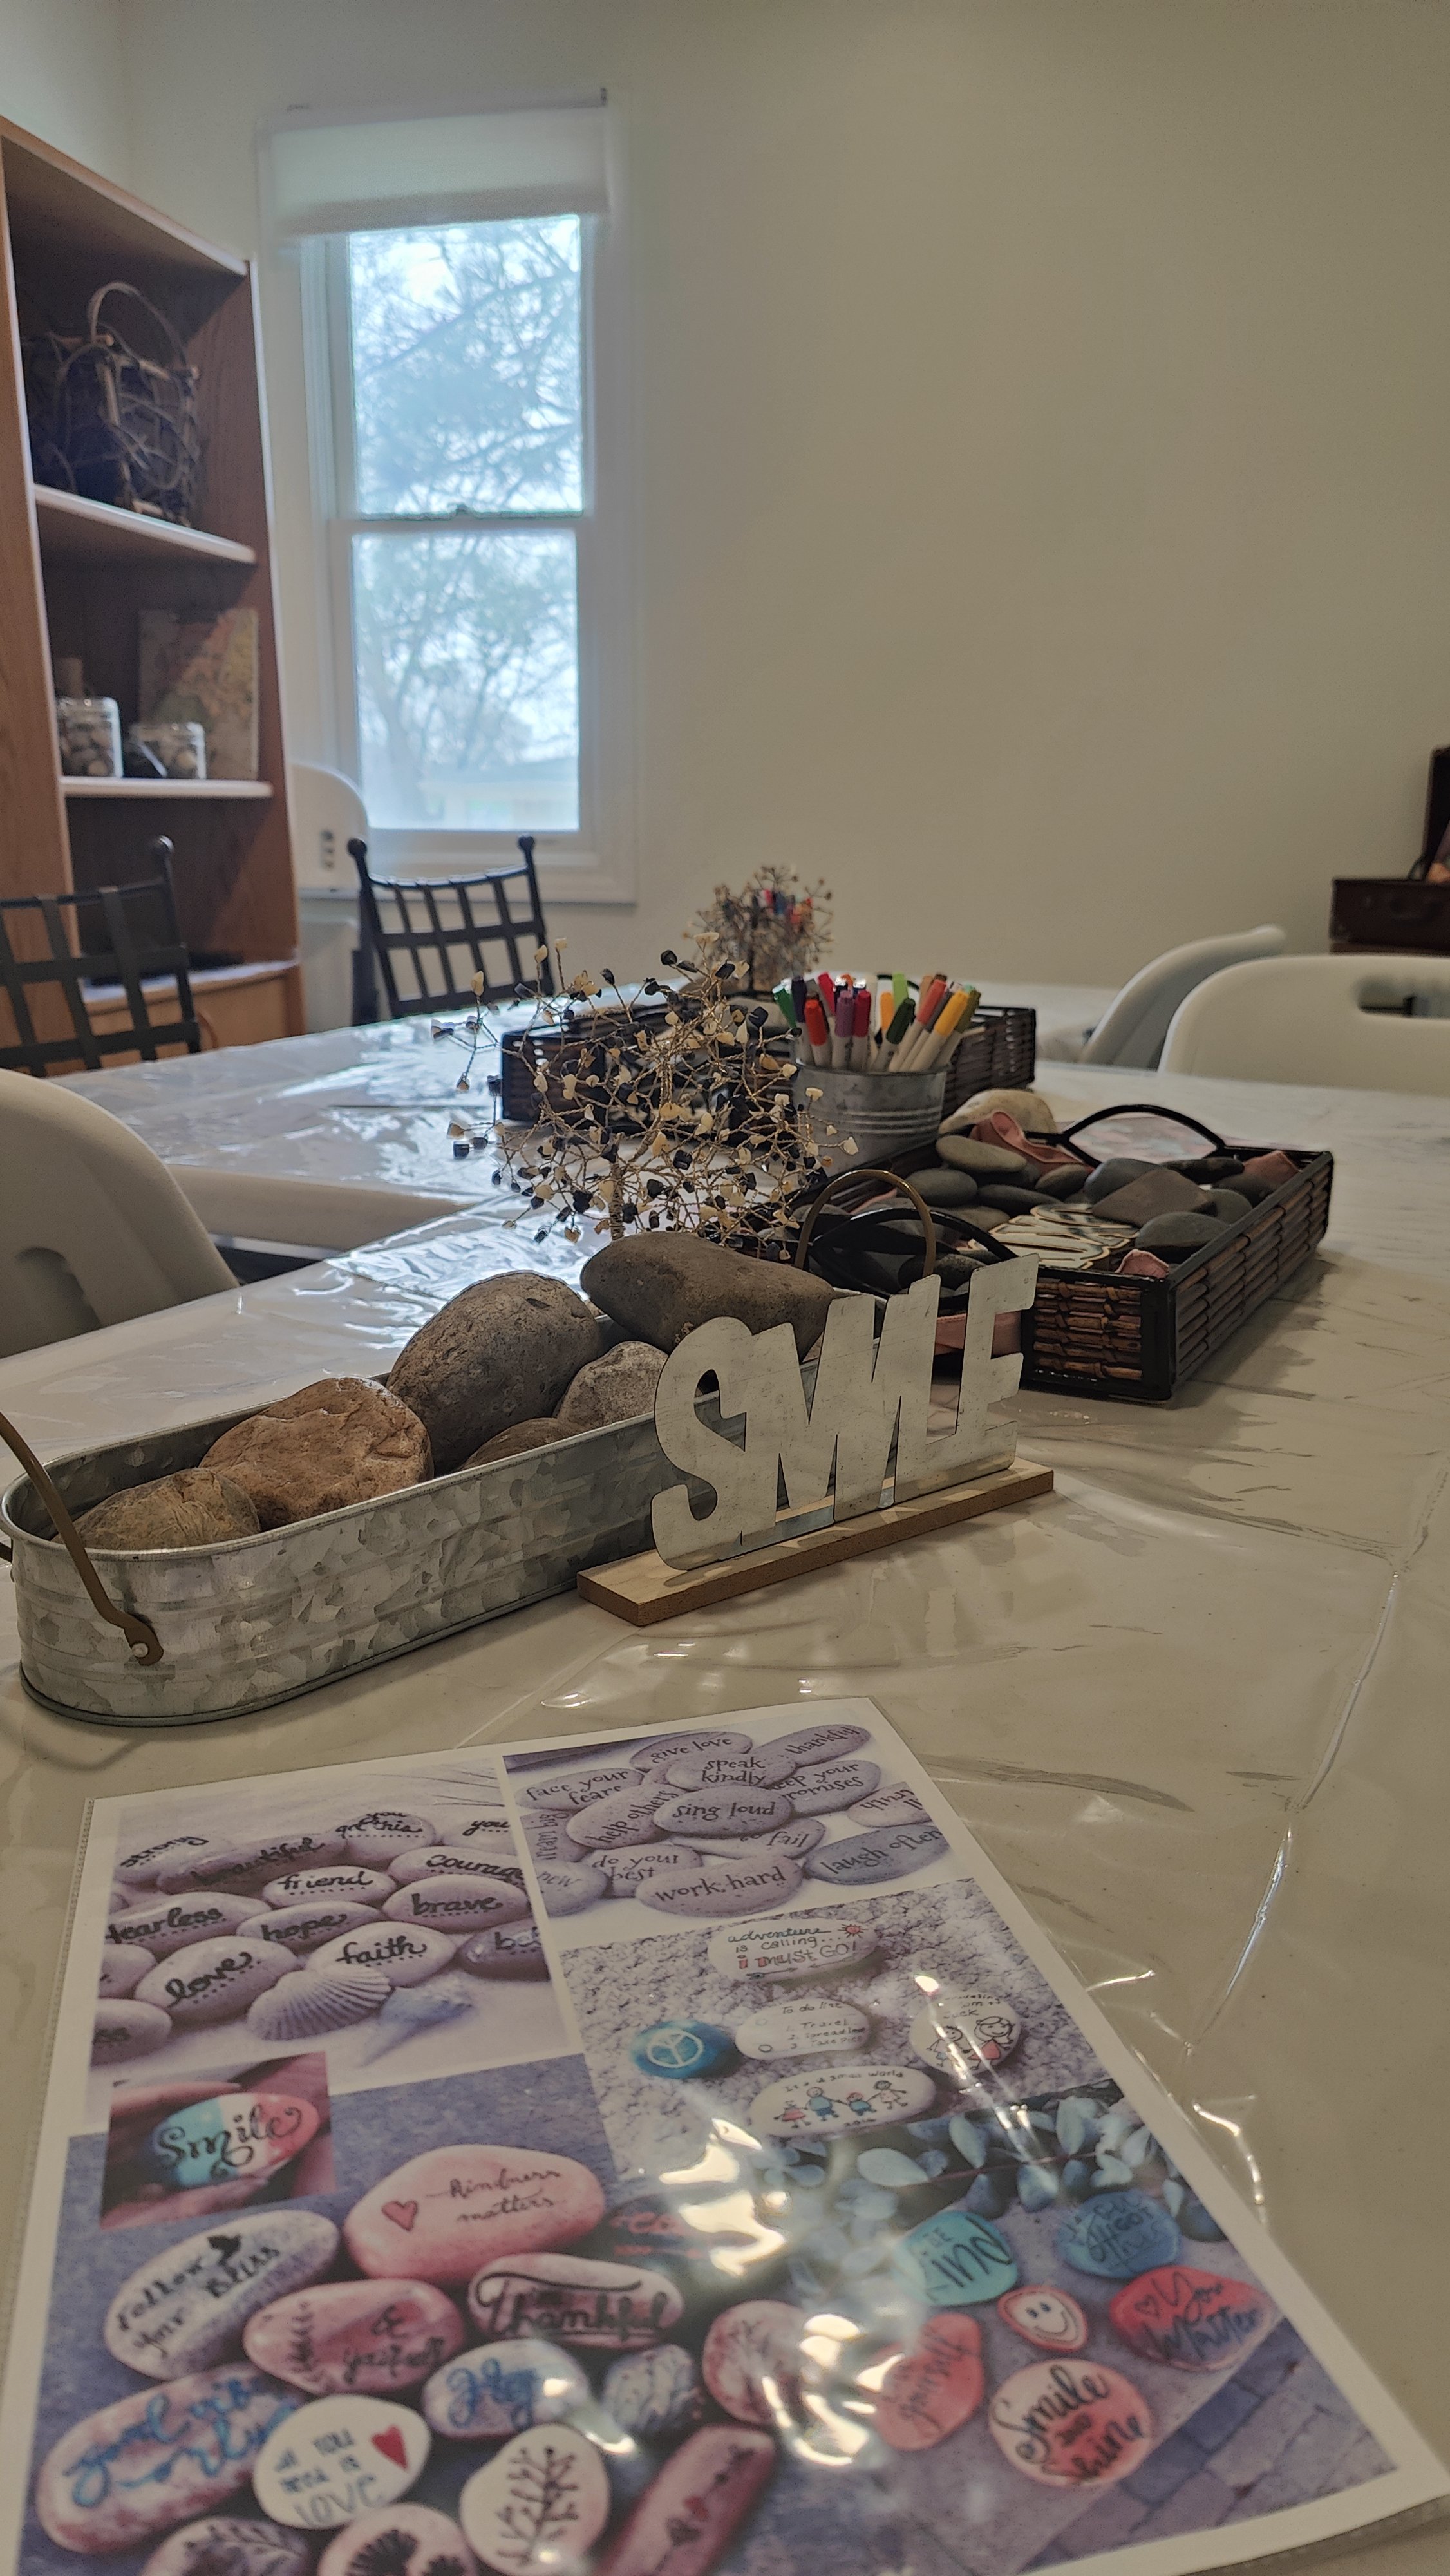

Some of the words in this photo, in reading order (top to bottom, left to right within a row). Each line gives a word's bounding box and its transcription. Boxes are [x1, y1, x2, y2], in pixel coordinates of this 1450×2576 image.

[651, 1253, 1039, 1571] SMILE
[651, 1747, 690, 1763] give
[692, 1738, 732, 1752] love
[785, 1727, 860, 1754] thankful
[704, 1756, 765, 1770] speak
[771, 1775, 805, 1790] eep
[814, 1763, 860, 1783] your
[526, 1784, 572, 1801] face
[579, 1771, 629, 1793] your
[702, 1770, 766, 1786] kindly
[585, 1821, 639, 1844] help
[628, 1790, 679, 1819] others
[673, 1804, 721, 1821] sing
[727, 1802, 775, 1817] loud
[767, 1831, 809, 1848] fail
[592, 1855, 619, 1868] do
[623, 1855, 679, 1871] your
[820, 1847, 889, 1875] laugh
[277, 1870, 374, 1891] friend
[655, 1877, 722, 1902] work
[730, 1866, 786, 1890] hard
[411, 1893, 504, 1916] brave
[261, 1913, 348, 1942] hope
[336, 1934, 428, 1968] faith
[165, 1951, 253, 2009] love
[155, 2104, 304, 2178] Smile
[992, 2363, 1111, 2466] Smile
